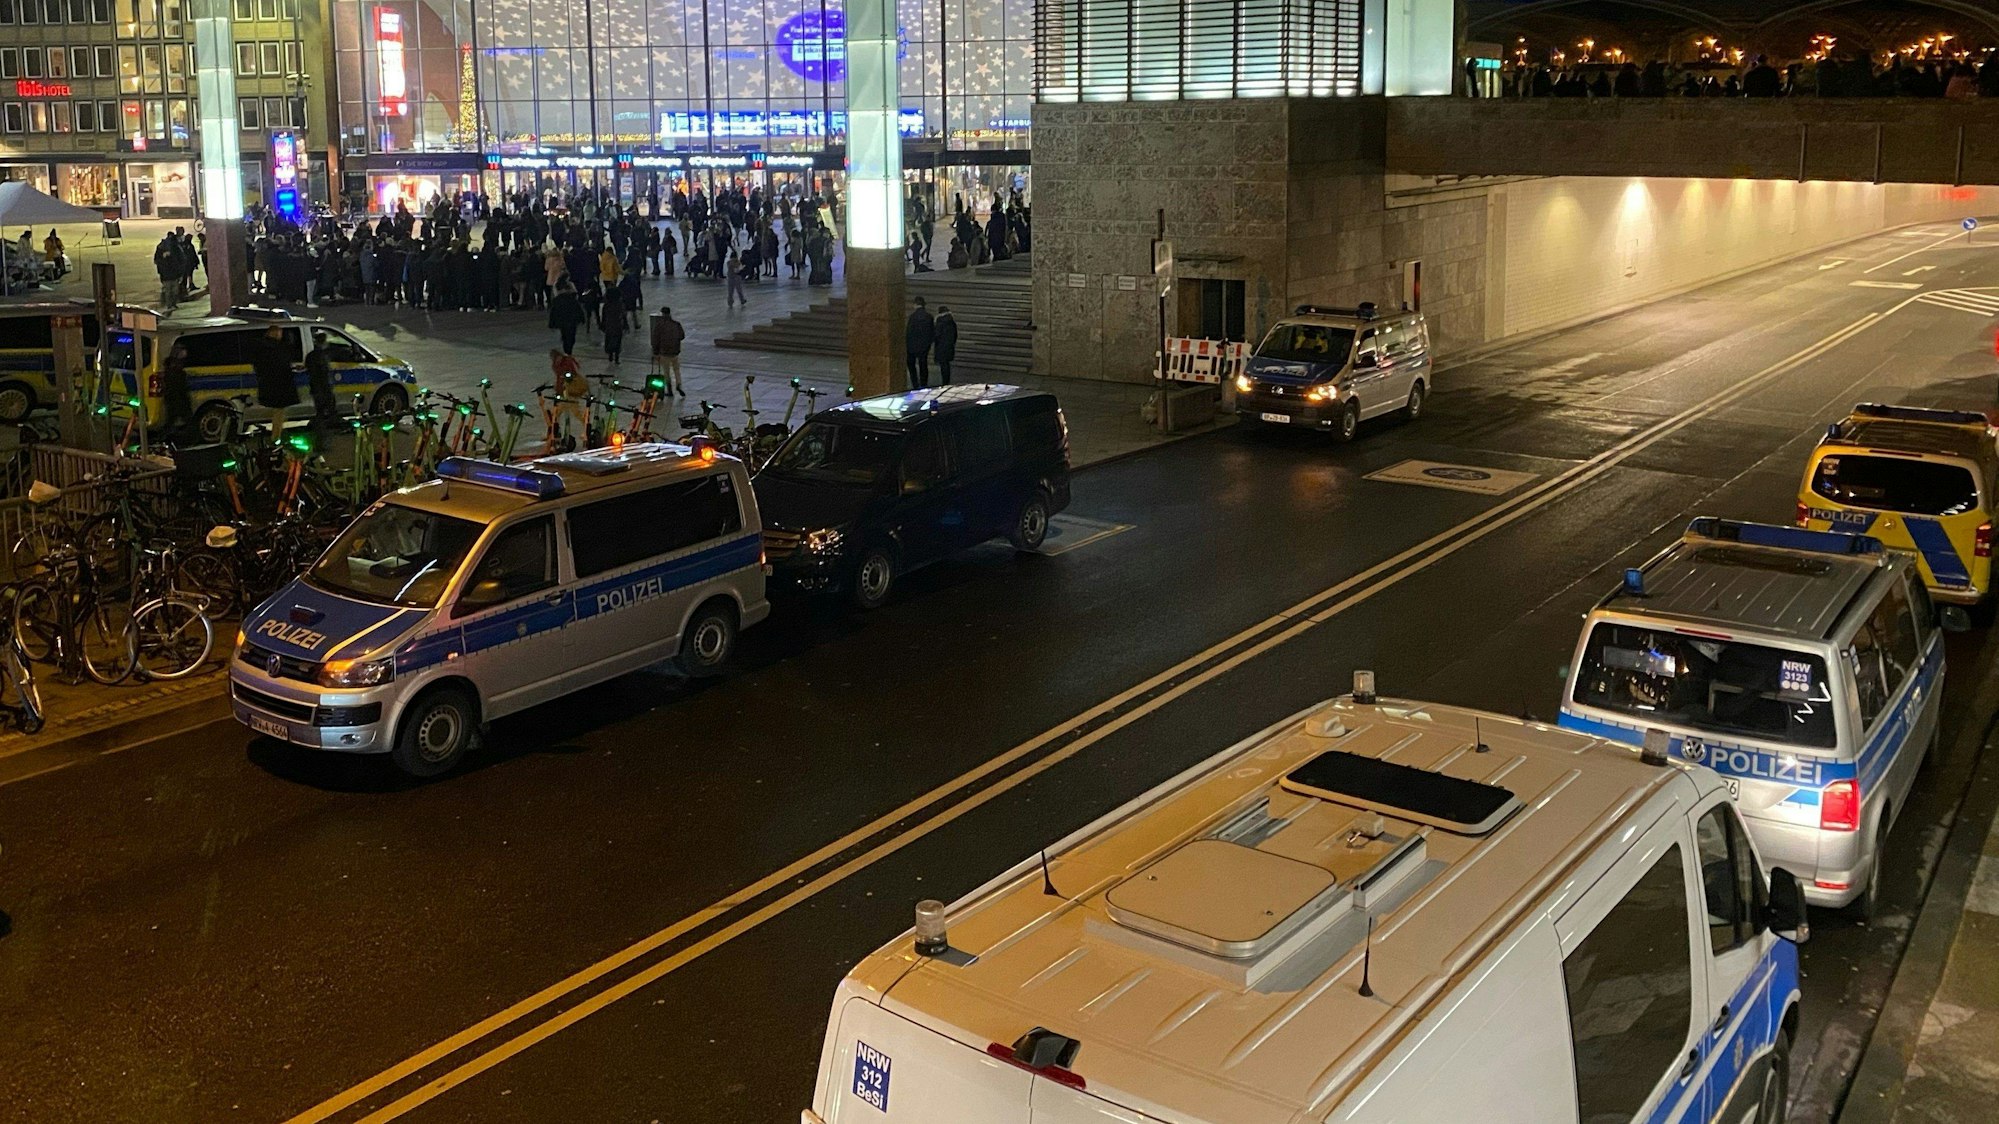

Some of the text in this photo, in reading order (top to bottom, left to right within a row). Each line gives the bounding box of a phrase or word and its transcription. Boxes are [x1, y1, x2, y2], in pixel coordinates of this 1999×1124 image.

[17, 80, 72, 96] ibis HOTEL
[1811, 508, 1866, 525] POLIZEI
[596, 577, 663, 613] POLIZEI
[256, 619, 327, 650] POLIZEI
[1782, 660, 1812, 673] NRW
[1784, 671, 1808, 682] 3123
[1710, 747, 1822, 785] POLIZEI
[857, 1041, 890, 1074] NRW
[861, 1065, 883, 1090] 312
[857, 1080, 884, 1110] BeSi
